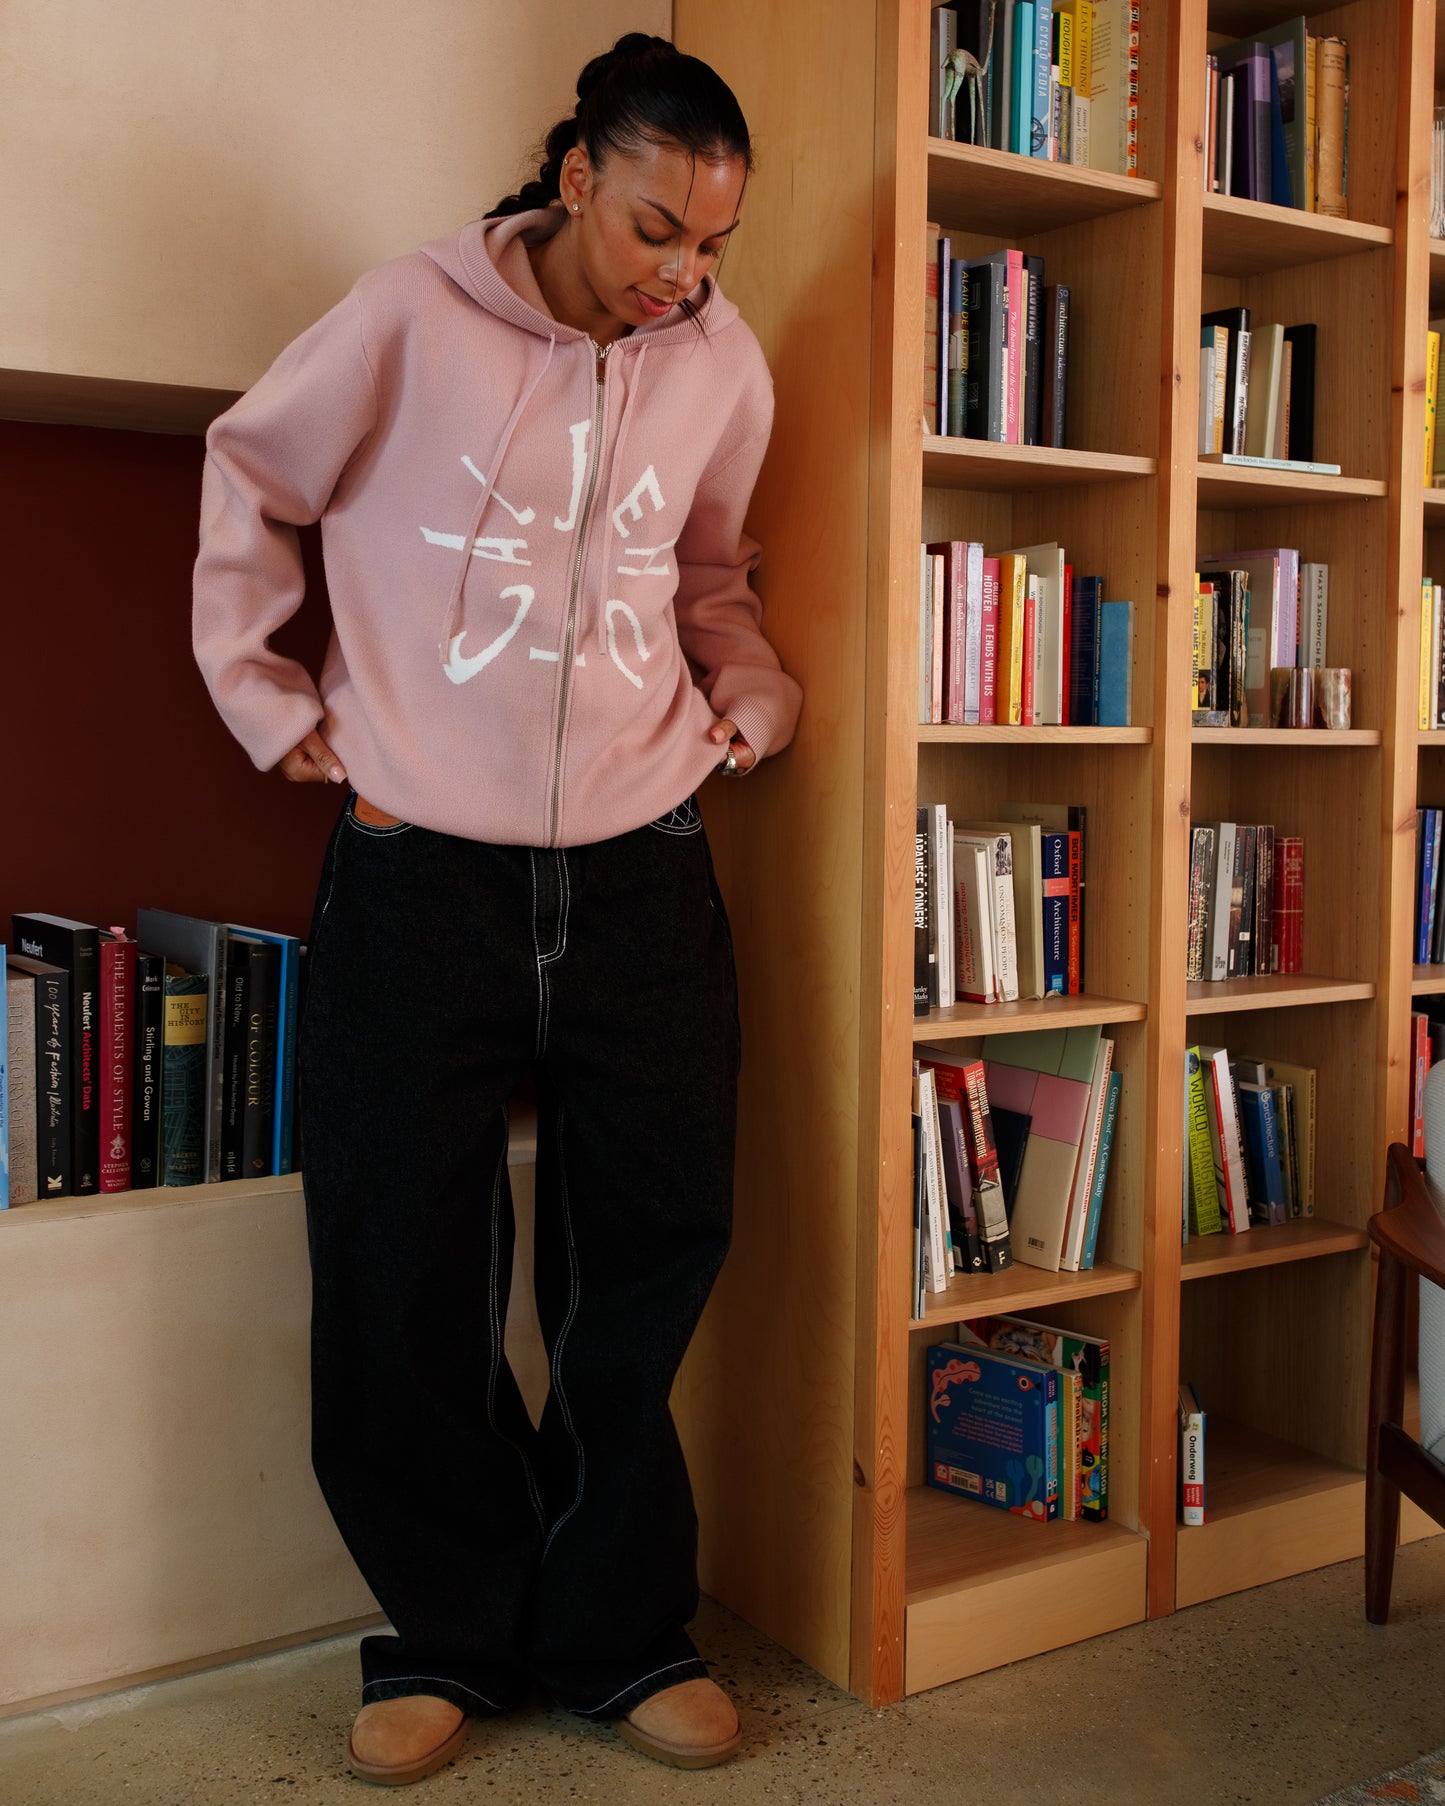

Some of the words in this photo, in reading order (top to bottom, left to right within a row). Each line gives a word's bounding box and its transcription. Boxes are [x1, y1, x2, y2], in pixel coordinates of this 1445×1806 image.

[1040, 7, 1048, 19] EN
[1039, 25, 1048, 58] CYCLO
[1039, 65, 1047, 97] PEDIA
[1062, 58, 1070, 83] RIDE
[961, 312, 968, 324] DE
[1058, 302, 1067, 355] architecture
[1216, 339, 1226, 375] TERRIBLE
[1214, 378, 1224, 418] KINDNESS
[983, 575, 992, 612] HOOVER
[985, 635, 993, 657] ENDS
[984, 660, 993, 683] WITH
[984, 685, 992, 696] US
[1054, 839, 1062, 875] Oxford
[914, 888, 927, 929] JOINERY
[1053, 900, 1062, 960] Architecture
[22, 938, 43, 958] Neufert
[114, 951, 124, 980] THE
[46, 980, 59, 1000] 100
[235, 977, 244, 991] Old
[43, 1003, 61, 1035] years
[82, 992, 92, 1030] Neufert
[113, 986, 124, 1059] ELEMENTS
[250, 1014, 263, 1033] OF
[82, 1032, 92, 1085] Architects'
[143, 1027, 155, 1061] Stirling
[9, 1046, 25, 1100] STORY
[45, 1052, 62, 1088] Fashion
[114, 1065, 124, 1083] OF
[144, 1064, 154, 1083] and
[248, 1040, 262, 1107] COLOUR
[966, 1071, 978, 1099] TOWARD
[975, 1068, 984, 1077] LE
[82, 1086, 92, 1110] Data
[113, 1089, 124, 1131] STYLE
[143, 1086, 154, 1121] Gowan
[970, 1101, 979, 1110] AN
[977, 1078, 990, 1116] CORBUSIER
[1108, 1087, 1119, 1112] Green
[972, 1111, 988, 1158] ARCHITECTURE
[1105, 1114, 1114, 1134] Roof
[1263, 1102, 1276, 1158] architecture
[1100, 1152, 1108, 1171] Case
[1095, 1173, 1106, 1198] Study
